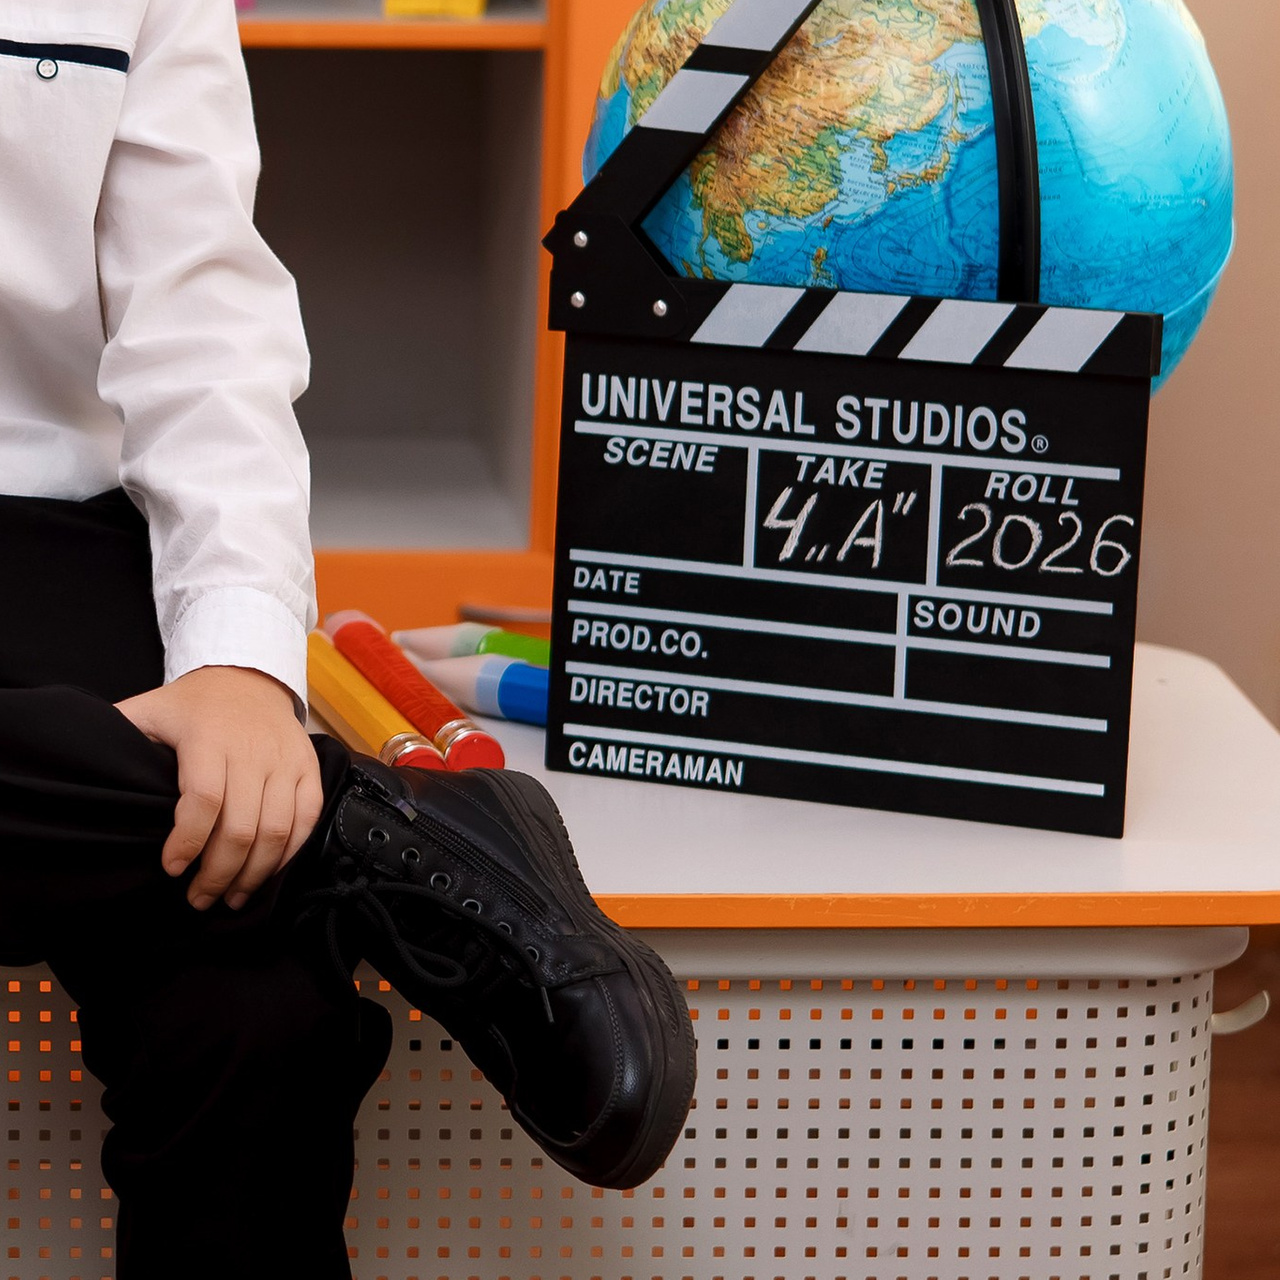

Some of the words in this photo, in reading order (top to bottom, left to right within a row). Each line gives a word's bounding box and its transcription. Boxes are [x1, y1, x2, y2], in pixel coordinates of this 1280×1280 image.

[580, 371, 817, 436] UNIVERSAL
[603, 435, 719, 474] SCENE
[795, 454, 888, 490] TAKE
[984, 471, 1080, 507] ROLL
[945, 502, 1136, 578] 2026
[572, 566, 641, 595] DATE
[571, 618, 709, 659] PROD.CO.
[913, 600, 1042, 639] SOUND
[569, 676, 710, 717] DIRECTOR
[568, 741, 744, 787] CAMERAMAN
